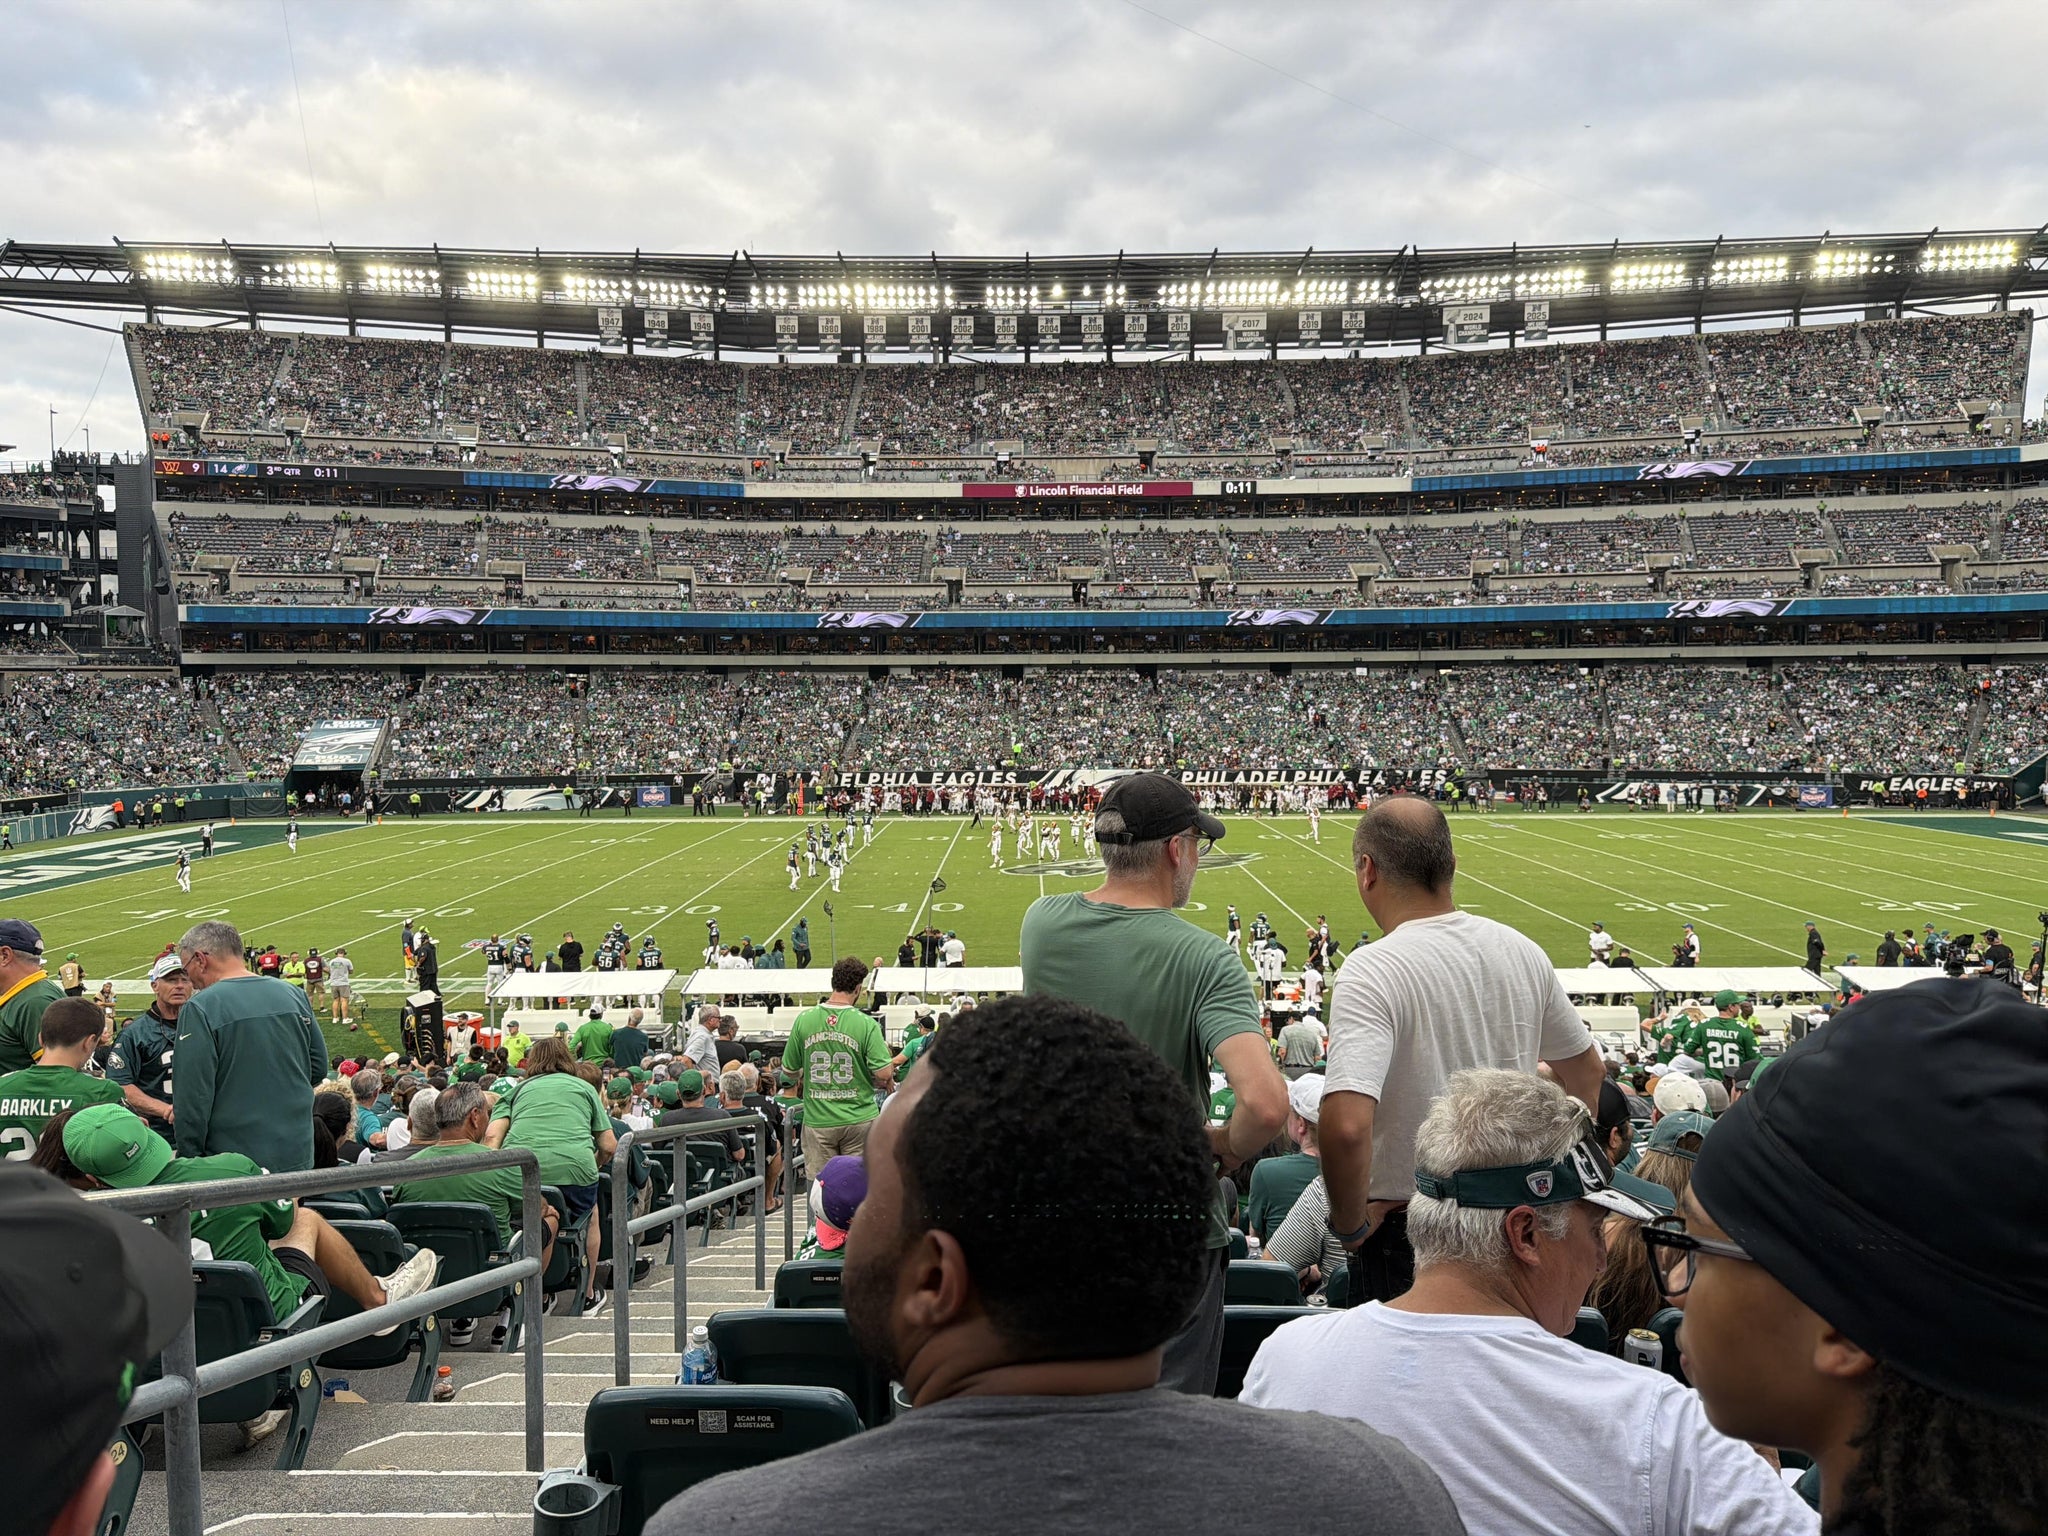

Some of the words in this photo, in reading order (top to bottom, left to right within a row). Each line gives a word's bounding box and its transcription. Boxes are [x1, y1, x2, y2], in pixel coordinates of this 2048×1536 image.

[1463, 313, 1483, 321] 2024
[1526, 312, 1547, 320] 2025
[601, 318, 620, 326] 1947
[648, 320, 665, 328] 1948
[694, 322, 711, 331] 1949
[1128, 323, 1144, 331] 2010
[1242, 320, 1260, 328] 2017
[1344, 320, 1363, 328] 2022
[779, 325, 796, 333] 1960
[821, 325, 838, 333] 1980
[911, 325, 928, 333] 2001
[953, 325, 972, 333] 2002
[997, 325, 1015, 333] 2003
[1040, 325, 1058, 333] 2004
[1083, 324, 1102, 332] 2006
[192, 463, 199, 472] 9
[213, 464, 228, 473] 14
[284, 467, 301, 476] QTR
[314, 468, 338, 478] 0:11
[1030, 485, 1067, 496] Lincoln
[1070, 485, 1116, 495] Financial
[1118, 484, 1143, 494] Field
[1226, 482, 1251, 494] 0:11
[931, 772, 1017, 786] EAGLES
[1181, 770, 1345, 784] PHILADELPHIA
[1889, 778, 1965, 791] EAGLES
[630, 904, 722, 915] 30
[880, 902, 965, 913] 40
[1614, 902, 1709, 912] 30
[1861, 900, 1962, 911] 20
[375, 907, 475, 918] 20
[1256, 927, 1268, 938] 13
[487, 951, 500, 961] 51
[598, 955, 613, 968] 56
[644, 956, 659, 968] 66
[1706, 1028, 1739, 1039] BARKLEY
[804, 1031, 859, 1052] MANCHESTER
[1706, 1041, 1740, 1069] 26
[810, 1050, 854, 1085] 23
[809, 1088, 858, 1099] TENNESSEE
[0, 1098, 72, 1117] BARKLEY
[111, 1443, 125, 1462] 24
